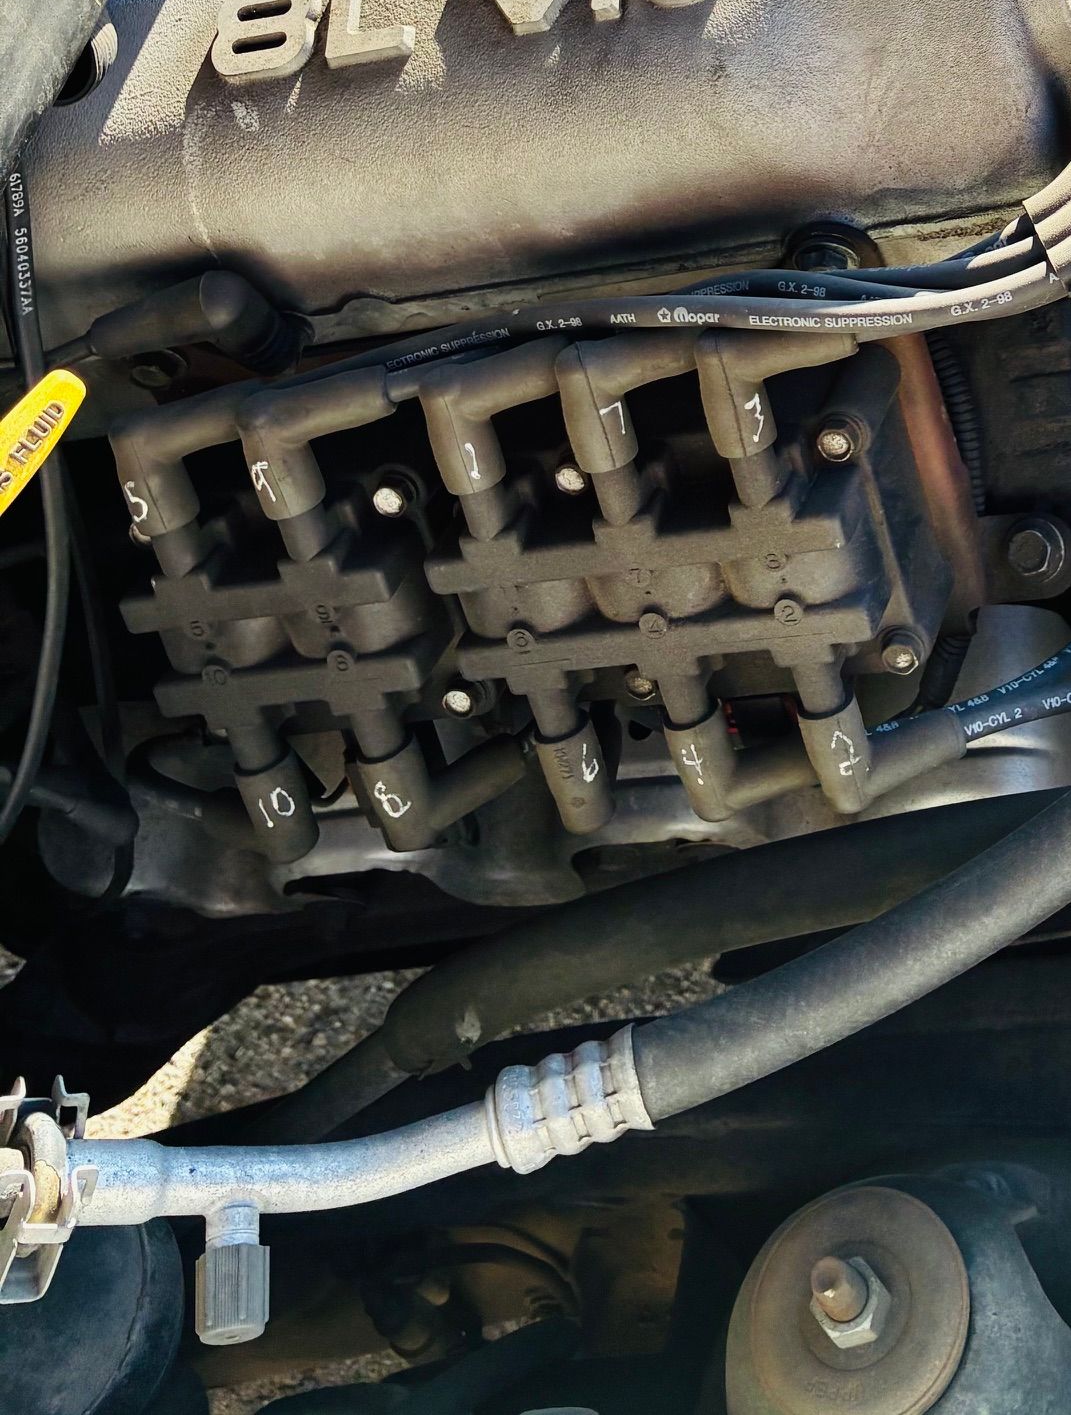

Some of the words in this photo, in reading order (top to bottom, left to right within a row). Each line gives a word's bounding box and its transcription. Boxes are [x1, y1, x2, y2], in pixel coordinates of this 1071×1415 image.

[441, 328, 511, 354] SUPPRESSION
[536, 319, 557, 332] G.X.
[558, 317, 583, 329] 2-98
[610, 313, 636, 325] AATH
[673, 306, 720, 326] Mopar
[749, 315, 821, 328] ELECTRONIC
[824, 313, 913, 329] SUPPRESSION
[950, 302, 979, 317] G.X.
[981, 290, 1013, 310] 2-98
[9, 402, 65, 465] FLUID
[600, 401, 626, 434] 7
[124, 481, 149, 522] 5
[782, 605, 798, 623] 2
[964, 711, 1012, 736] V10-CYL
[1013, 706, 1022, 720] 2
[582, 743, 599, 783] 6
[259, 787, 296, 828] 10
